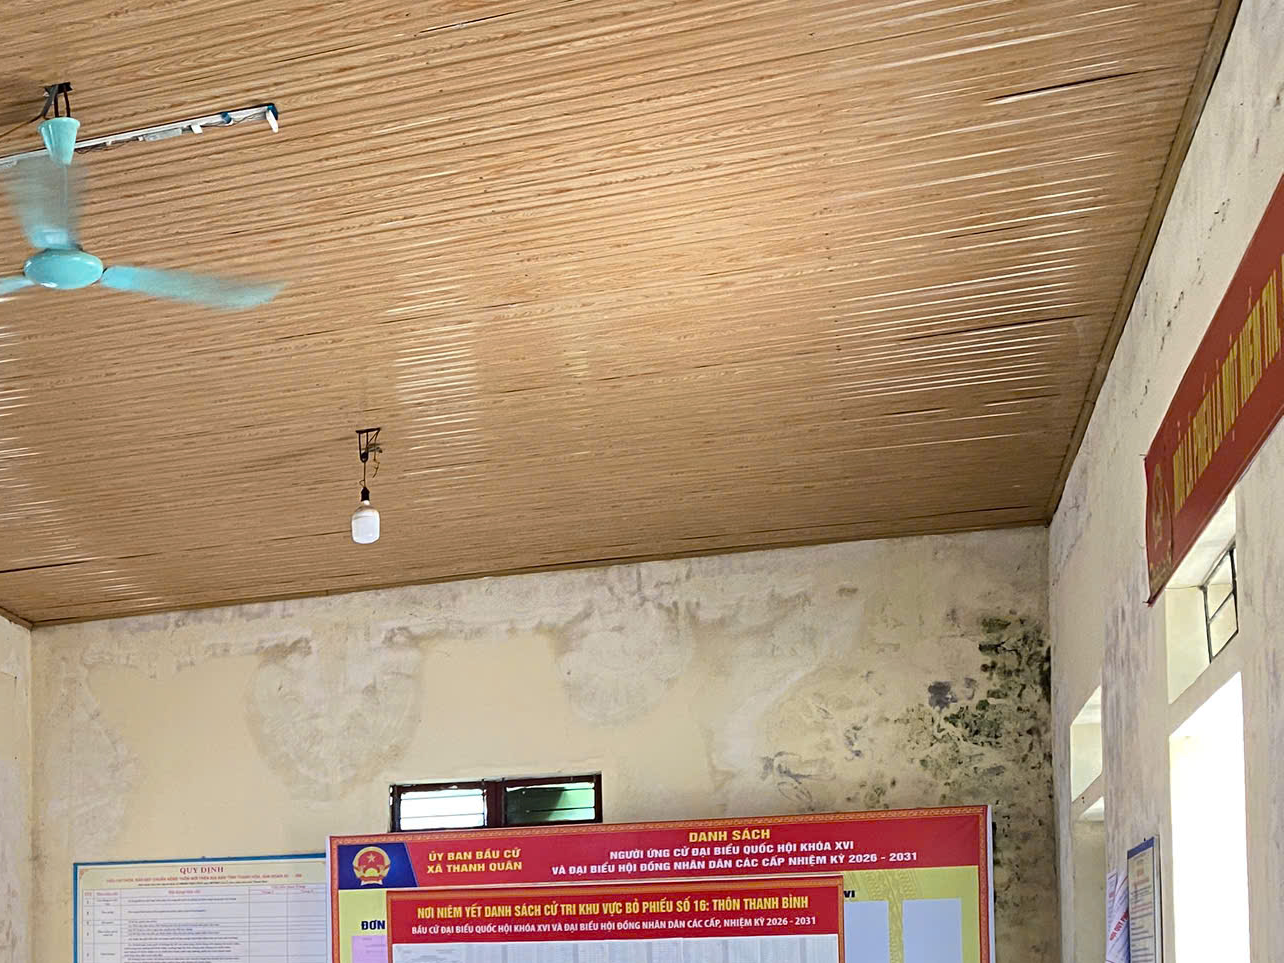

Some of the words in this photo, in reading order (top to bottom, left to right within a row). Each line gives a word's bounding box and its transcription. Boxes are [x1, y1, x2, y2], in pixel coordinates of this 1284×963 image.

[689, 830, 727, 842] DANH
[732, 828, 770, 841] SÁCH
[447, 851, 472, 861] BAN
[503, 846, 521, 858] CỬ
[610, 848, 644, 859] NGƯỜI
[647, 848, 670, 858] ỨNG
[673, 845, 690, 857] CỬ
[691, 847, 710, 857] ĐẠI
[714, 842, 739, 855] BIỂU
[743, 842, 774, 854] QUỐC
[777, 842, 796, 854] HỘI
[800, 840, 831, 852] KHÓA
[835, 840, 854, 850] XVI
[180, 866, 198, 874] QUY
[427, 863, 443, 873] XÃ
[446, 862, 485, 873] THANH
[489, 860, 522, 871] QUÂN
[552, 864, 566, 875] VÀ
[568, 865, 587, 876] ĐẠI
[590, 861, 615, 873] BIỂU
[618, 862, 636, 874] HỘI
[640, 861, 670, 872] ĐỒNG
[673, 859, 705, 870] NHÂN
[708, 858, 732, 869] DÂN
[736, 856, 759, 868] CÁC
[762, 855, 785, 867] CẤP
[788, 855, 827, 867] NHIỆM
[848, 853, 877, 863] 2026
[889, 852, 917, 862] 2031
[417, 907, 434, 918] NƠI
[437, 905, 462, 918] NIÊM
[465, 902, 482, 918] YẾT
[484, 905, 512, 918] DANH
[514, 902, 541, 917] SÁCH
[544, 900, 558, 916] CỬ
[560, 903, 576, 916] TRI
[579, 903, 599, 915] KHU
[602, 901, 623, 917] VỰC
[625, 898, 640, 914] BỎ
[642, 896, 673, 914] PHIẾU
[676, 896, 691, 912] SỐ
[694, 900, 710, 912] 16:
[712, 896, 740, 911] THÔN
[743, 896, 779, 910] THANH
[782, 894, 808, 909] BÌNH
[361, 920, 385, 930] ĐƠN
[412, 923, 427, 934] BẦU
[429, 923, 439, 934] CỬ
[441, 925, 454, 935] ĐẠI
[456, 923, 474, 934] BIỂU
[476, 923, 497, 933] QUỐC
[498, 924, 512, 934] HỘI
[514, 923, 535, 933] KHÓA
[537, 923, 550, 932] XVI
[552, 923, 562, 932] VÀ
[564, 923, 578, 933] ĐẠI
[580, 920, 599, 931] BIỂU
[601, 921, 615, 932] HỘI
[617, 920, 640, 930] ĐỒNG
[642, 919, 666, 930] NHÂN
[668, 918, 685, 929] DÂN
[687, 918, 703, 928] CÁC
[724, 917, 752, 929] NHIỆM
[767, 917, 788, 927] 2026
[795, 916, 816, 925] 2031
